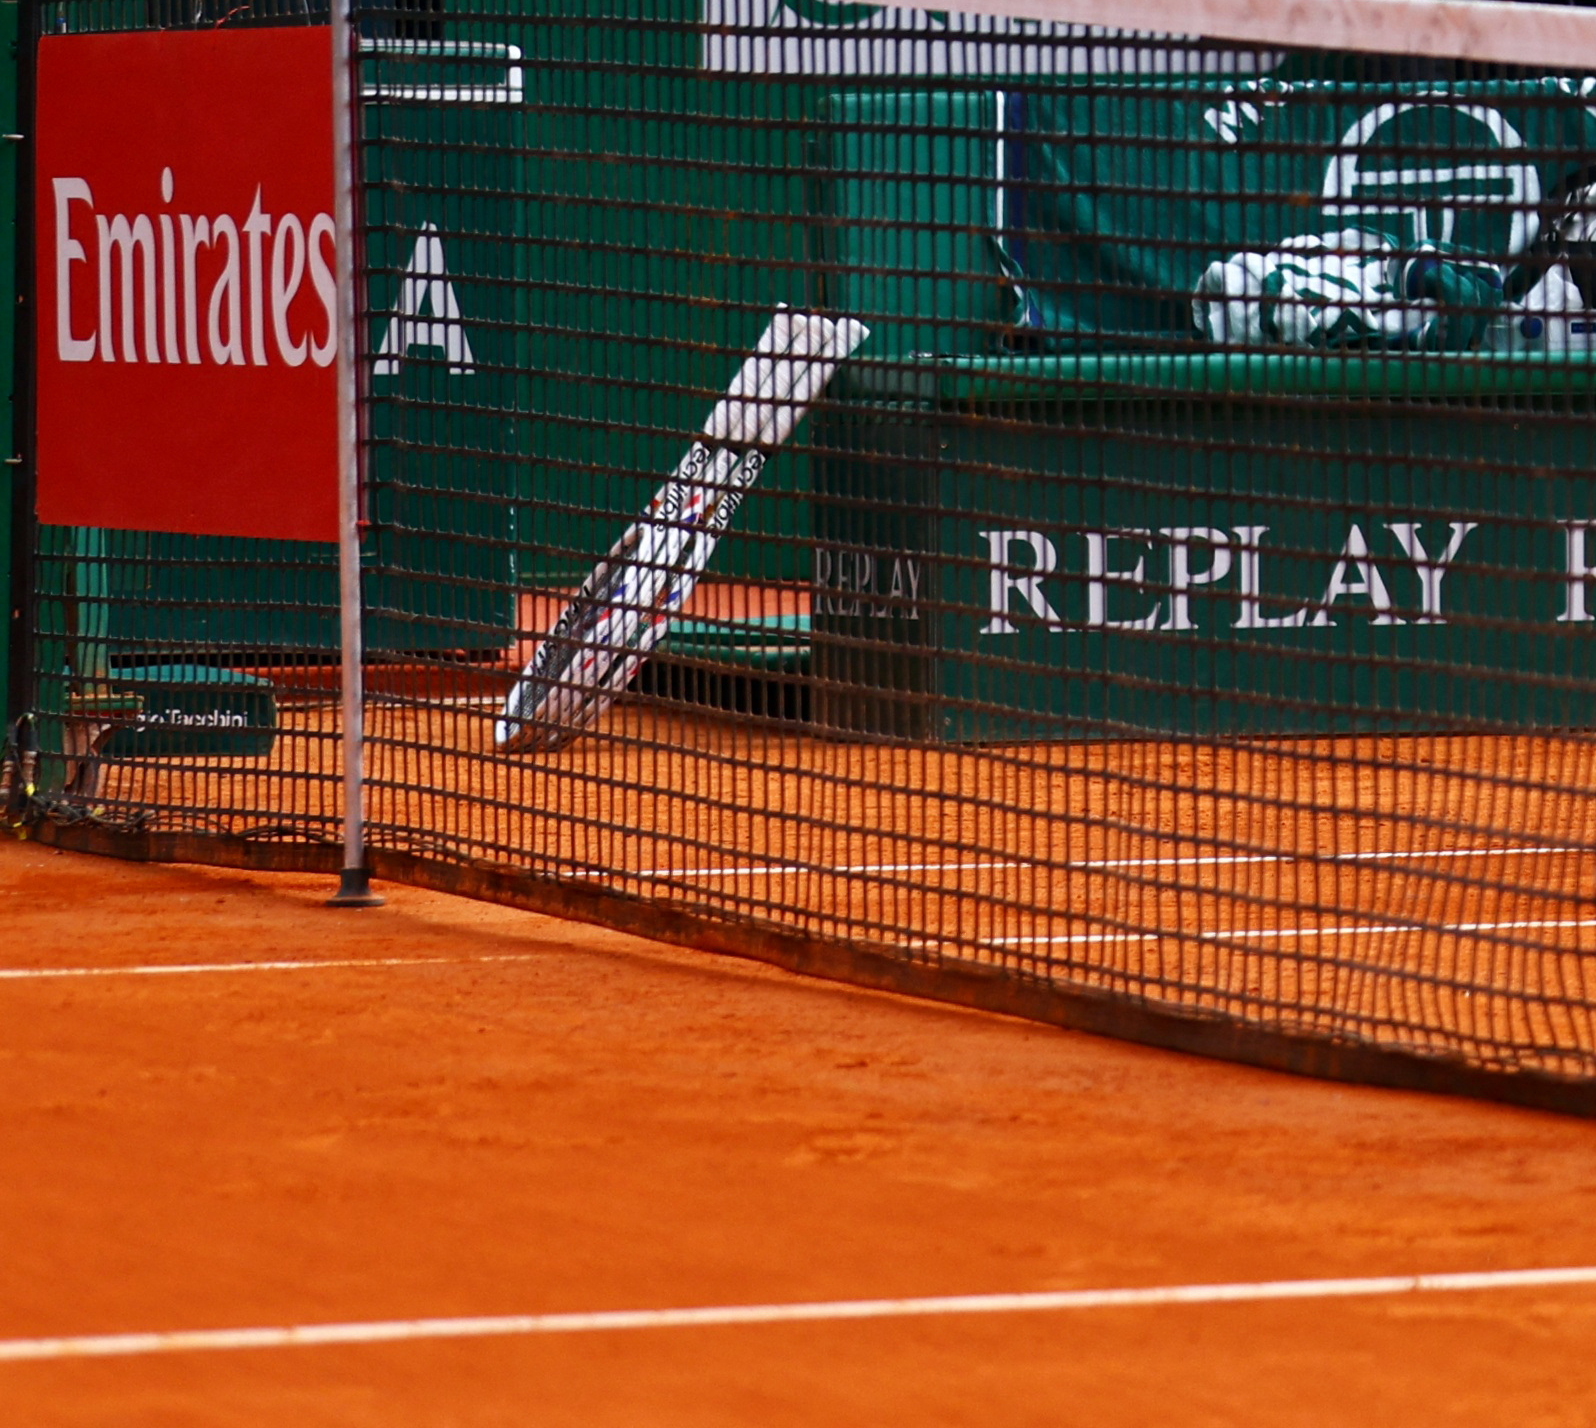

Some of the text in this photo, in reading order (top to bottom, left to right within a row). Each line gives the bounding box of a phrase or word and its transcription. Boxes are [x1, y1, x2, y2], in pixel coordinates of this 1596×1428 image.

[52, 166, 339, 368] Emirates
[814, 547, 921, 620] REPLAY
[979, 521, 1479, 636] REPLAY
